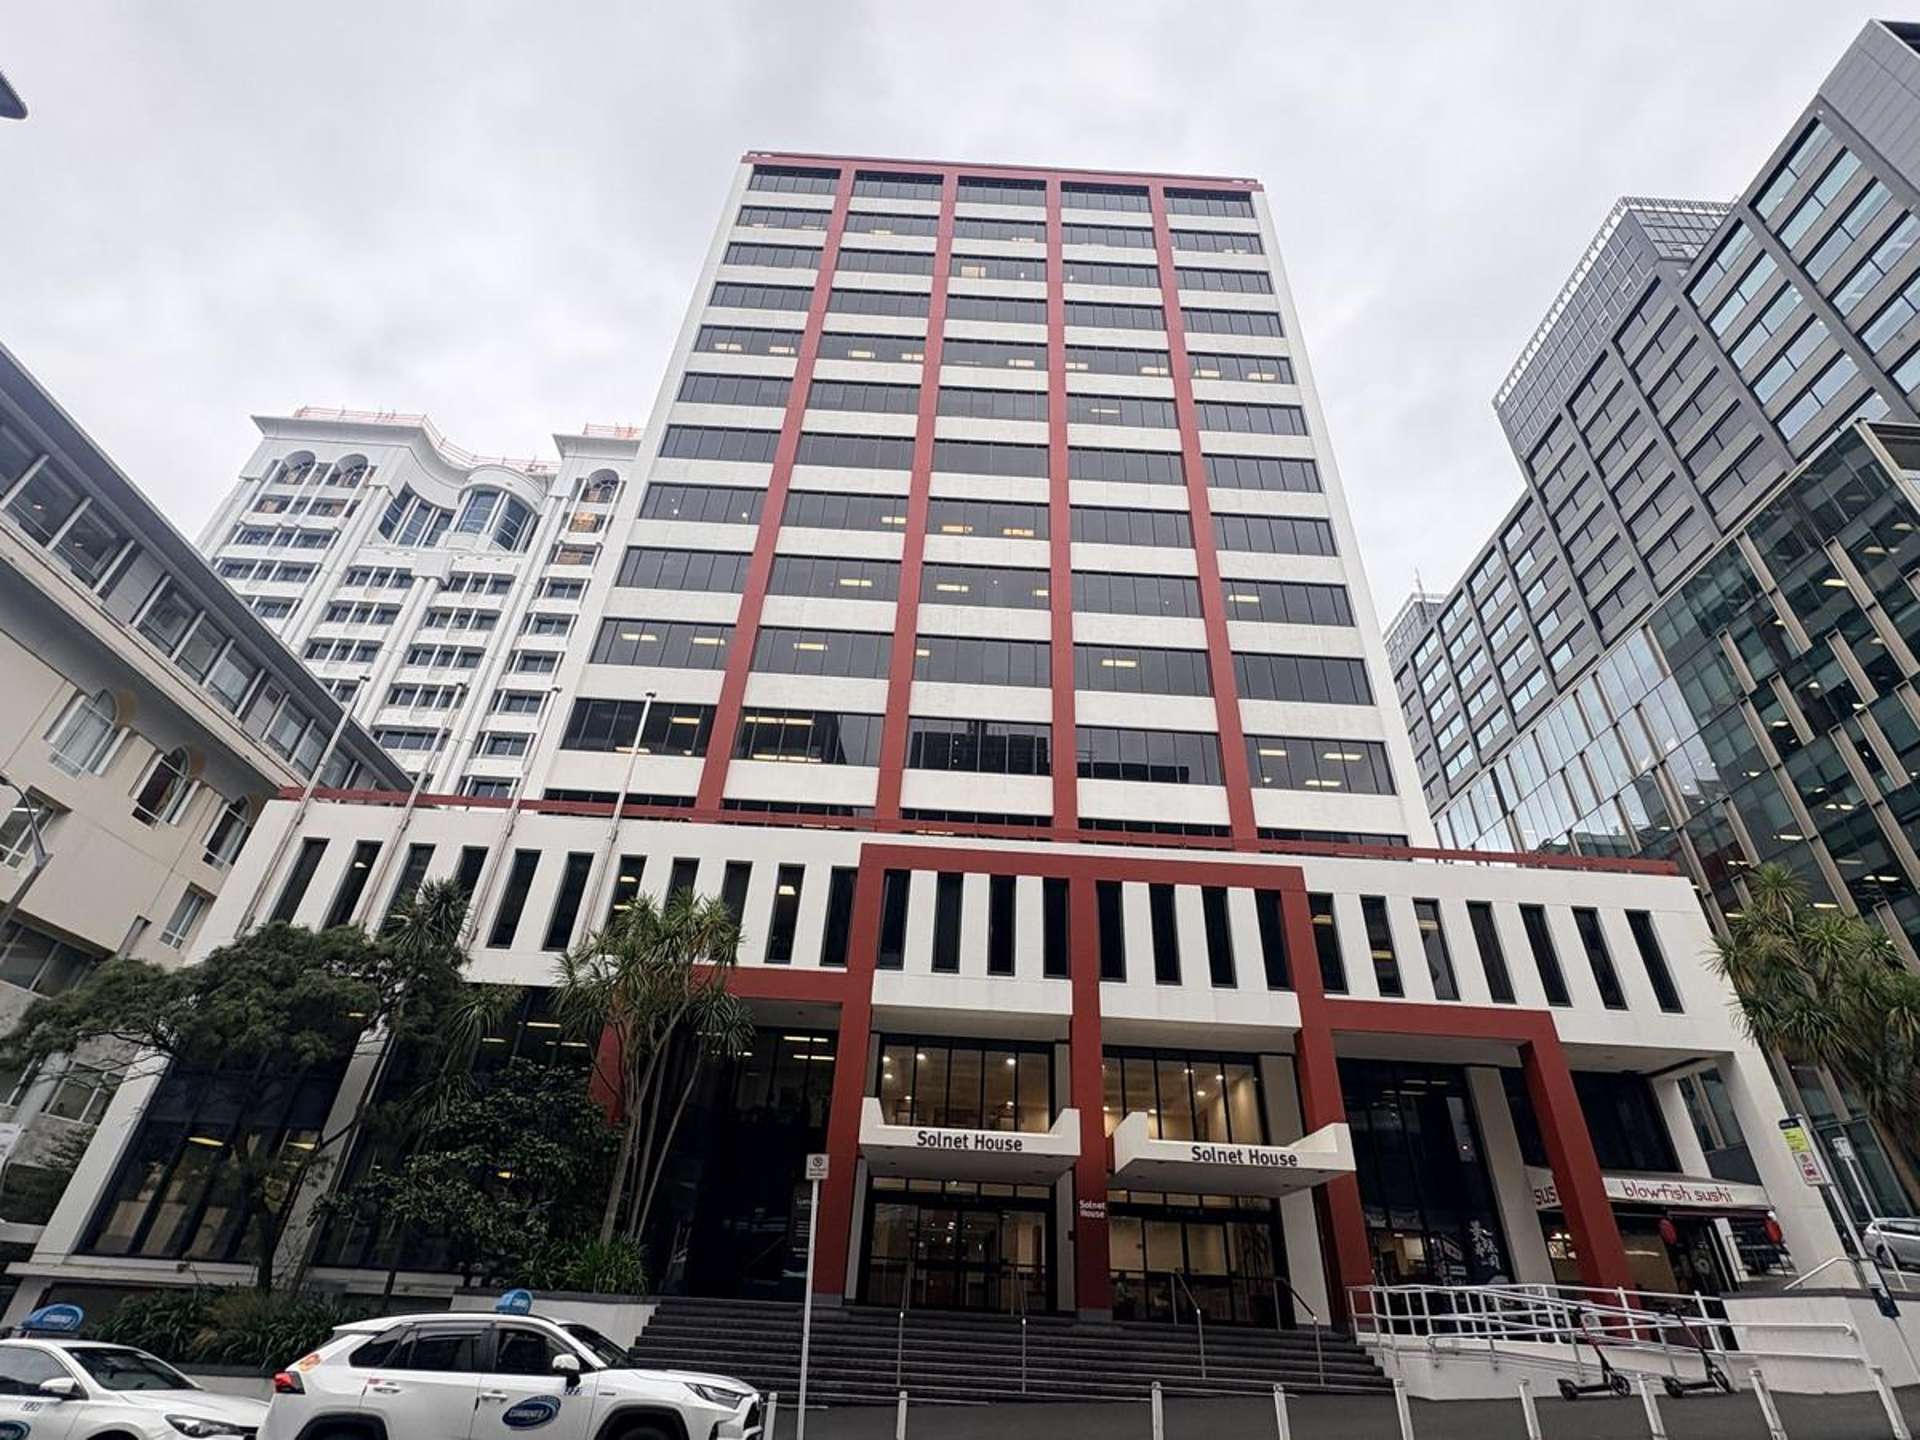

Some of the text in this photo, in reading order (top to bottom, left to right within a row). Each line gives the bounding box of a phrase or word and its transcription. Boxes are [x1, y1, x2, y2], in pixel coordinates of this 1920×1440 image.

[917, 1130, 1023, 1151] Solnet House
[1191, 1145, 1297, 1167] Solnet House
[1621, 1180, 1733, 1203] blowfish sushi
[1079, 1199, 1105, 1209] Solnet
[1080, 1209, 1105, 1218] House
